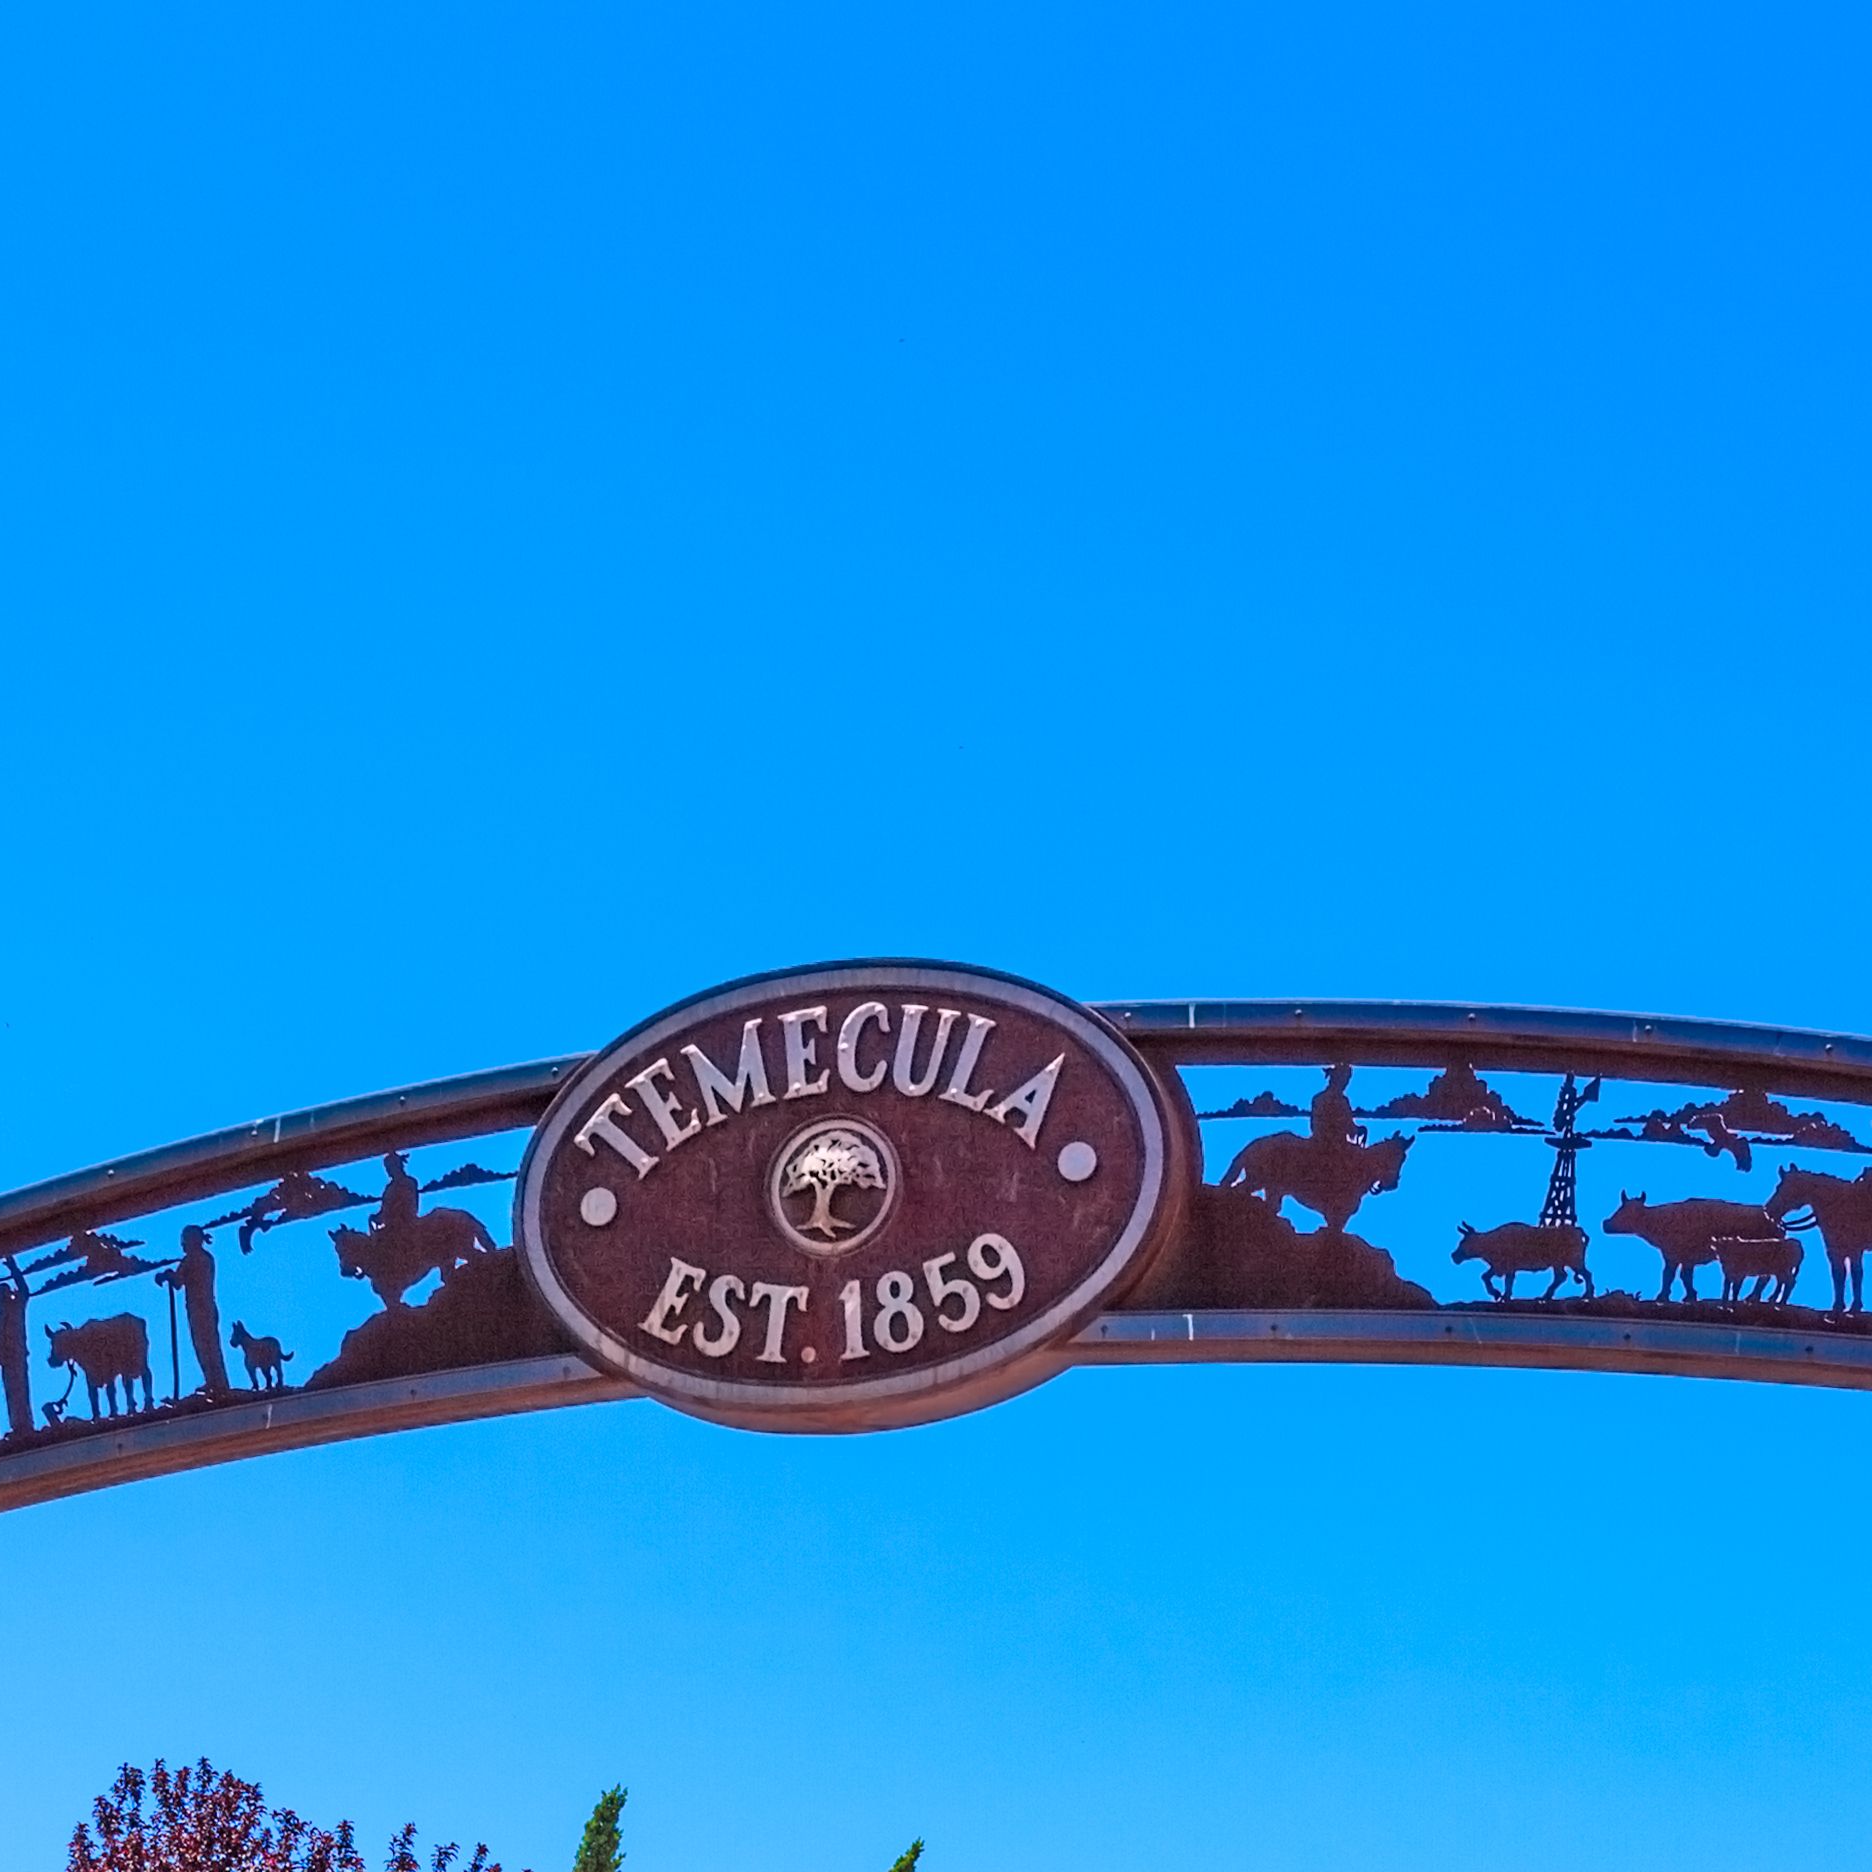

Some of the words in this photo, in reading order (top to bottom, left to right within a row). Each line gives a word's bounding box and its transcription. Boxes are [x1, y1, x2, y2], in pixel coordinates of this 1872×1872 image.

[574, 1001, 1066, 1180] TEMECULA
[638, 1256, 817, 1364] EST.
[838, 1232, 1025, 1361] 1859
